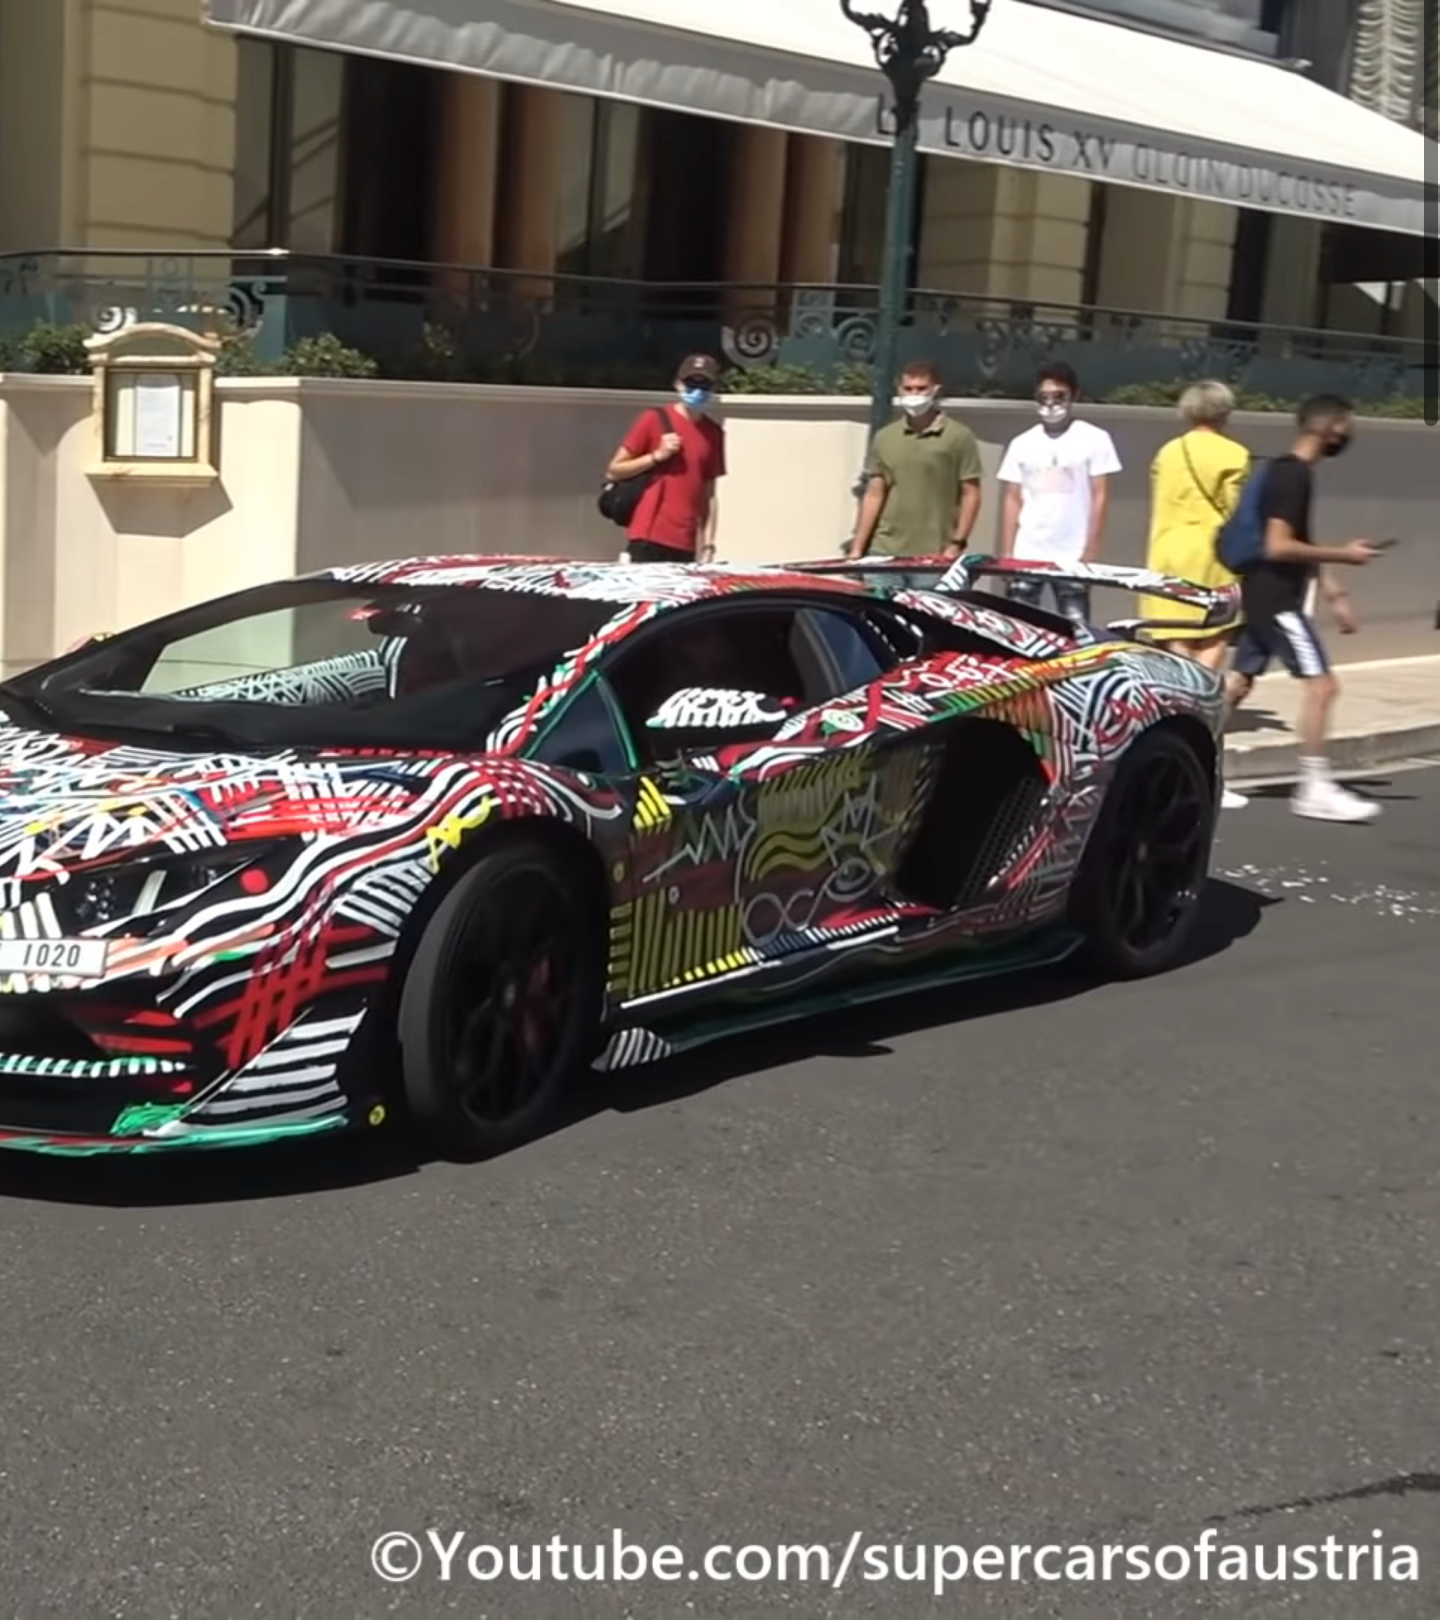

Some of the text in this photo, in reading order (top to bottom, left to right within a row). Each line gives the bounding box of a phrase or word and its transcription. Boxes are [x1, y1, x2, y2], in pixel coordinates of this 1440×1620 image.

[876, 93, 919, 141] L
[944, 106, 1054, 162] LOUIS
[1072, 131, 1117, 169] XV
[23, 943, 82, 967] 1020
